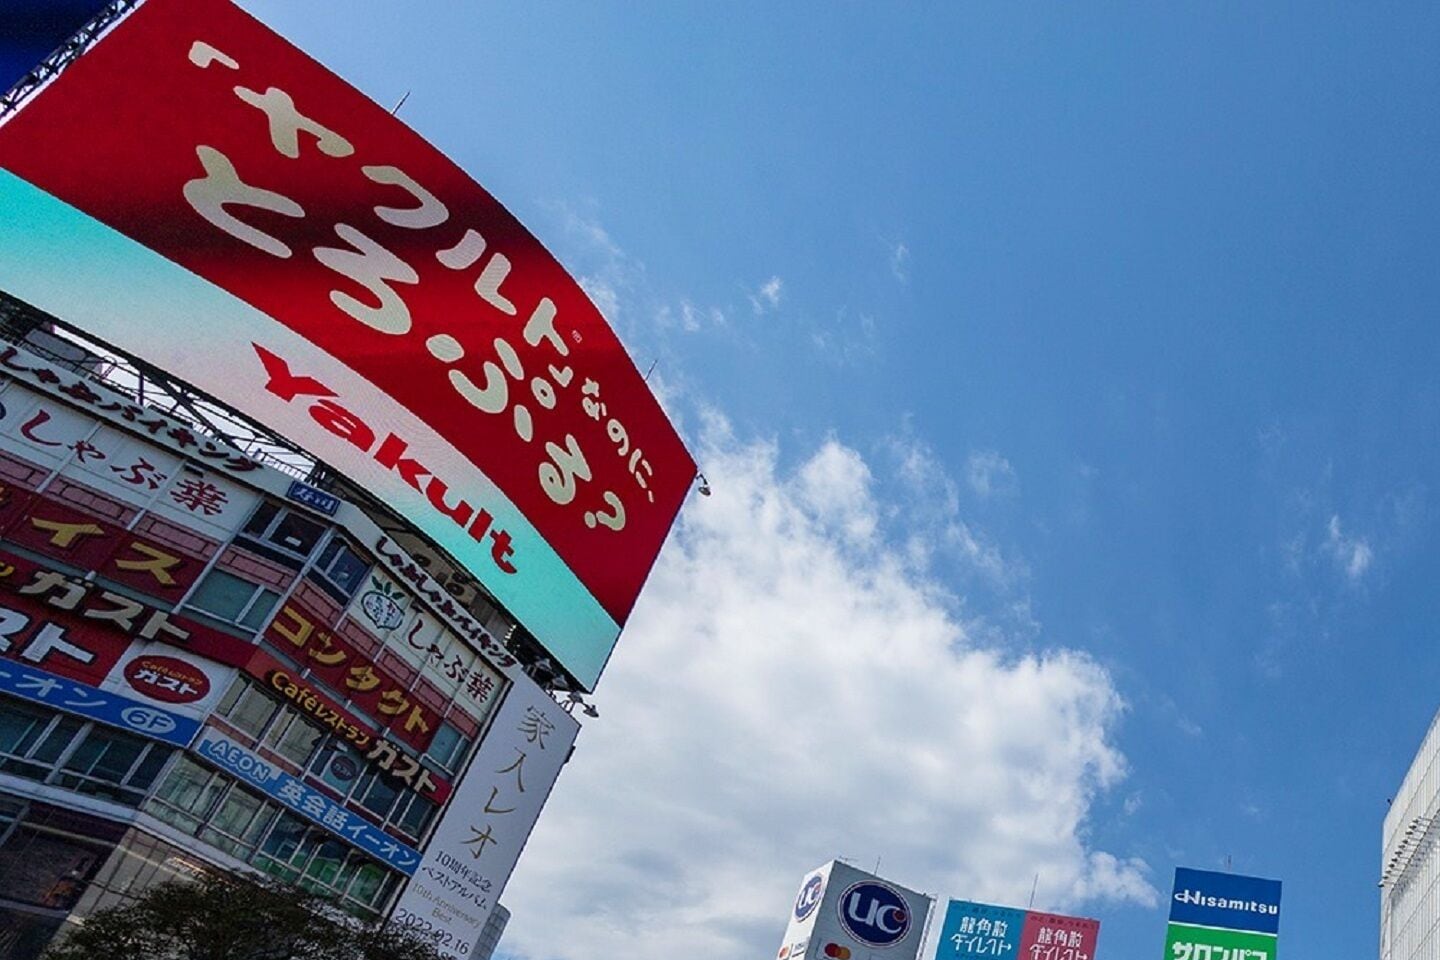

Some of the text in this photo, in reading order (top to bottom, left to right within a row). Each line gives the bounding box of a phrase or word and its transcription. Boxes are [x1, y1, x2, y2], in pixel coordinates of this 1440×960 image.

[21, 409, 229, 516] しゃぶ葉
[250, 341, 518, 574] Yakult
[18, 570, 190, 640] ガスト
[133, 669, 198, 694] ガスト
[271, 605, 430, 734] コンタクト
[408, 619, 495, 703] しゃぶ葉
[0, 670, 107, 707] オン
[271, 671, 370, 745] Caféレストラン
[127, 709, 172, 729] 6F
[211, 740, 270, 782] AEON
[367, 738, 437, 793] ガスト
[460, 705, 556, 860] 家入レオ
[277, 781, 417, 866] 英会話イーオン
[421, 866, 487, 911] ベストアルバム
[848, 891, 906, 934] UC
[1174, 888, 1279, 915] Hisamitsu
[959, 916, 1008, 938] 龍角散
[1037, 926, 1083, 949] 龍角散
